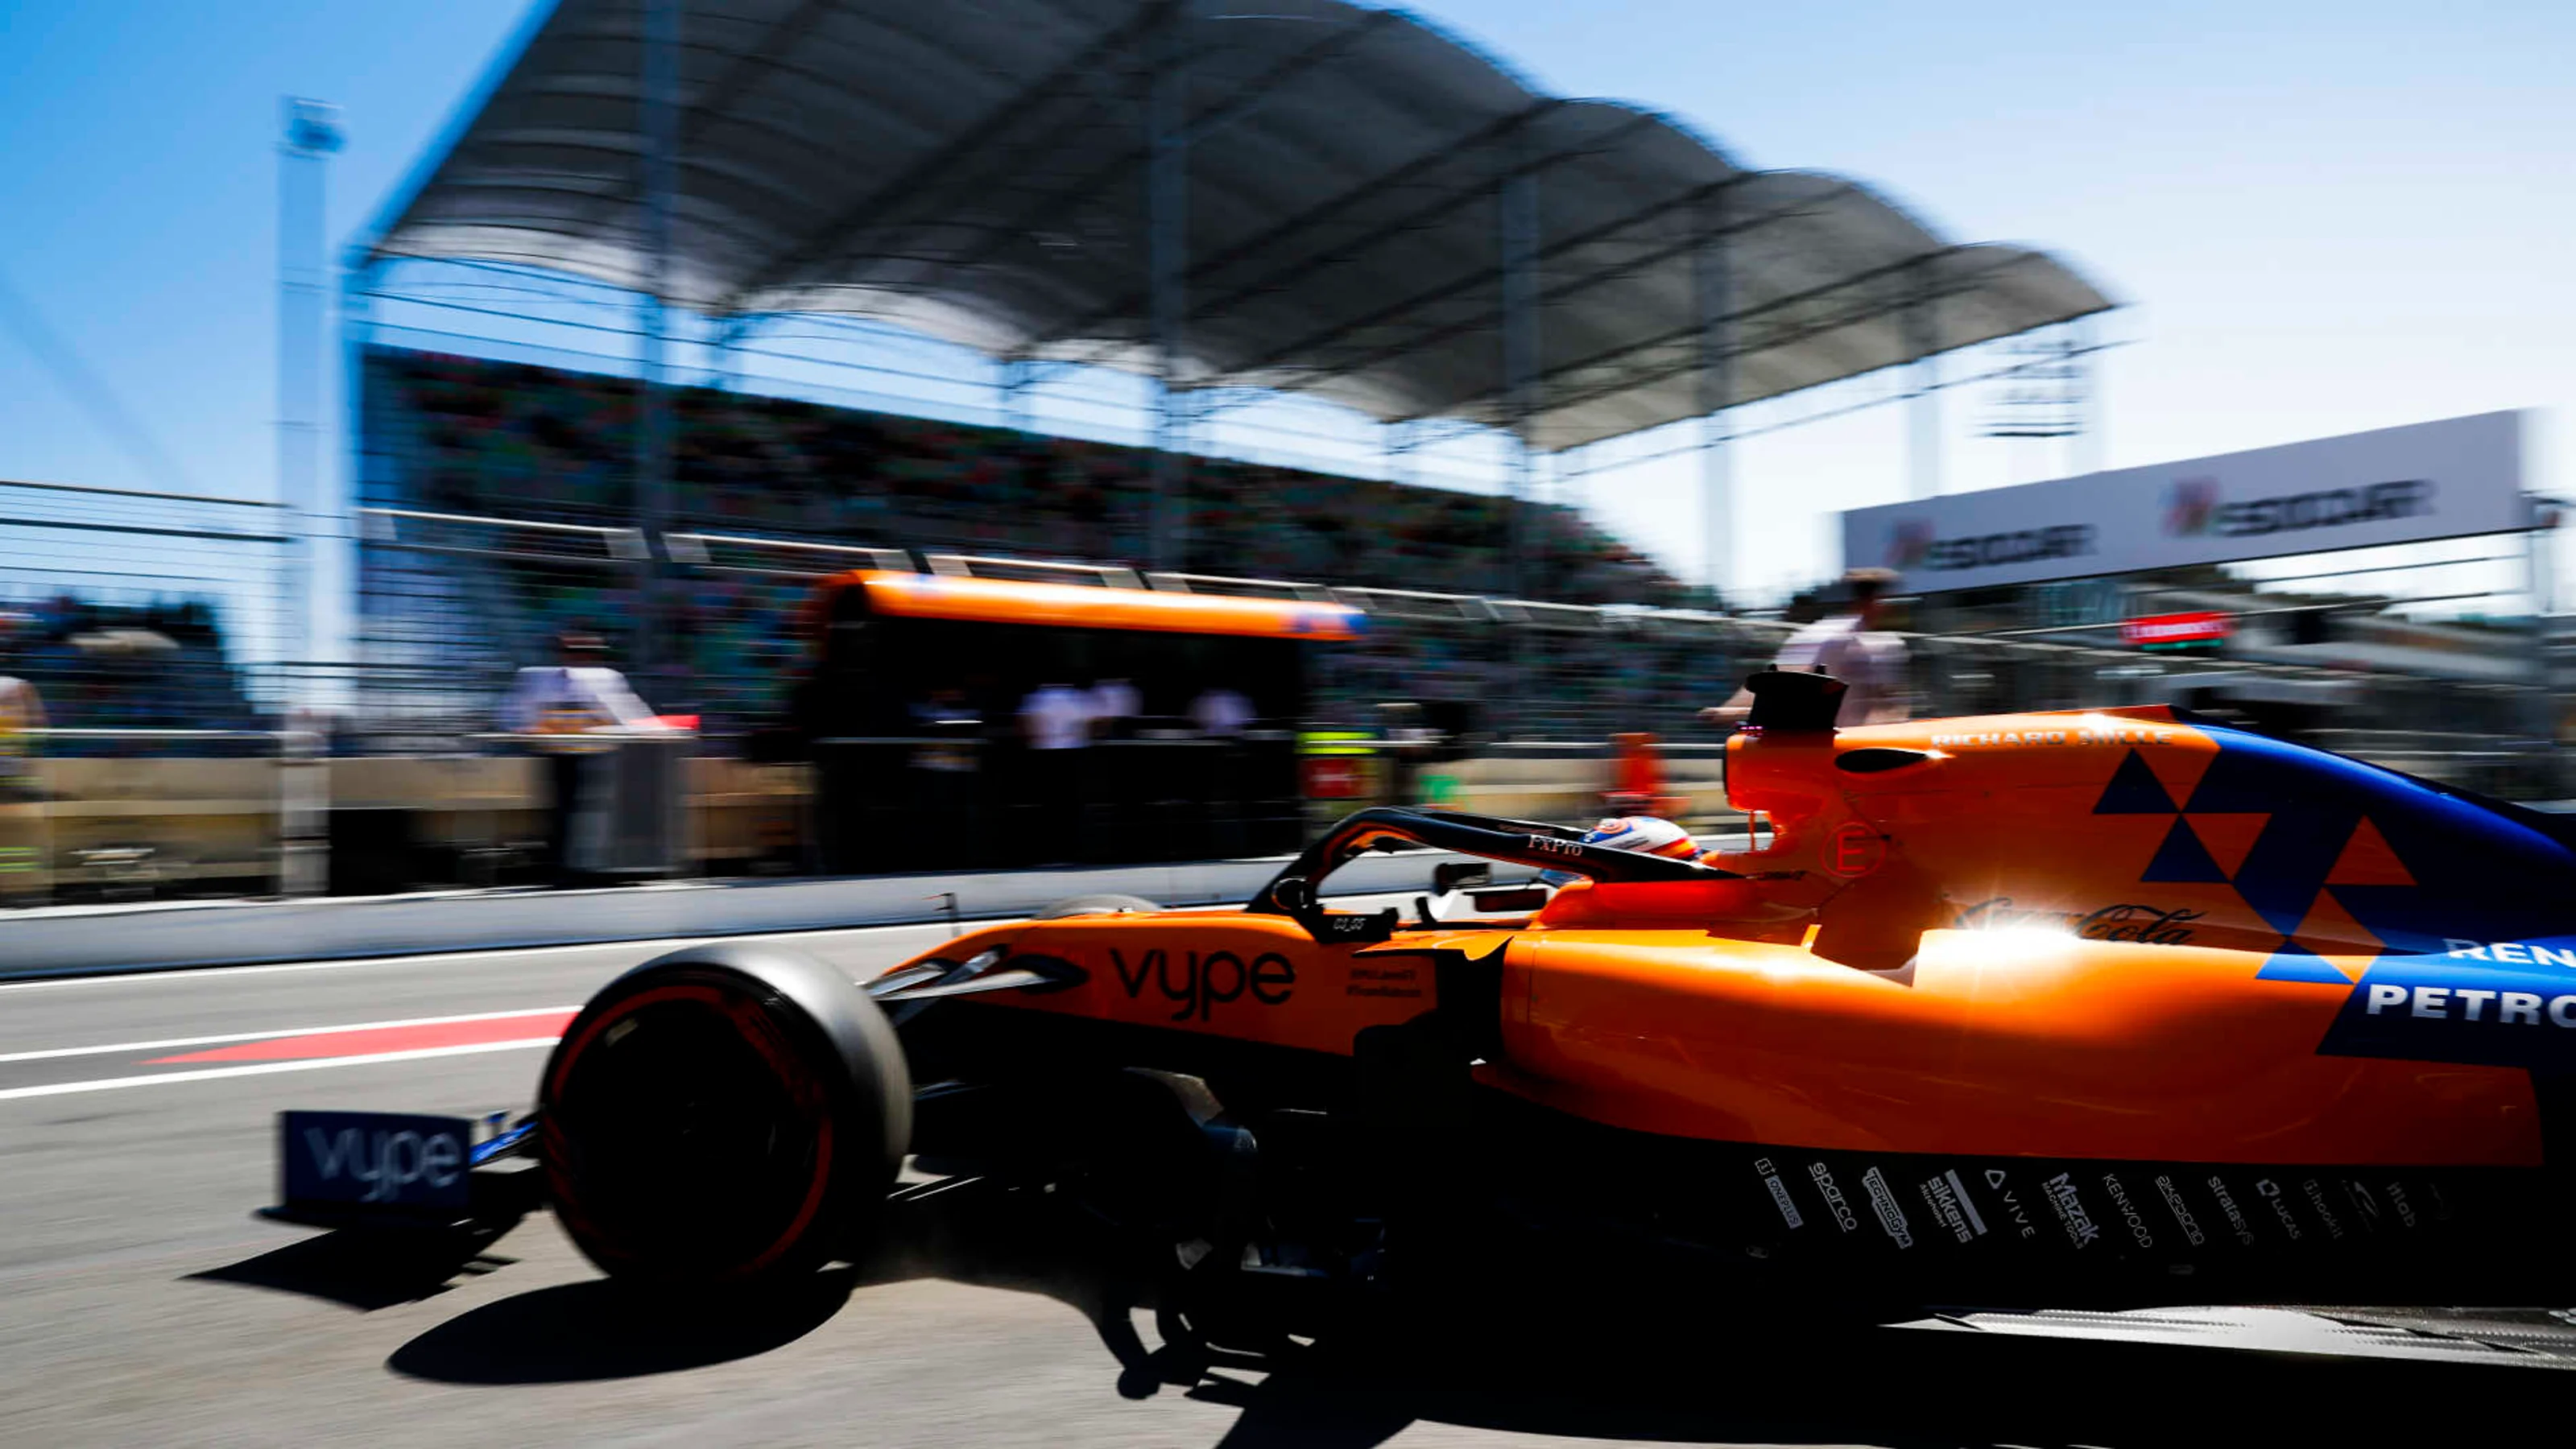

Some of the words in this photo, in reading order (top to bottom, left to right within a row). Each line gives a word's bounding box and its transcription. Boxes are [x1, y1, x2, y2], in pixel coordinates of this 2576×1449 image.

[1930, 730, 2065, 747] RICHARD
[2078, 729, 2172, 745] MILLE
[1837, 831, 1867, 871] E
[2442, 938, 2576, 968] REN
[1109, 947, 1296, 1022] vype
[304, 1127, 461, 1203] vype
[1767, 1176, 1802, 1228] ONEPLUS
[1809, 1162, 1858, 1232] sparco
[1928, 1177, 1972, 1242] sikkens
[2003, 1190, 2036, 1238] VIVE
[2042, 1183, 2067, 1220] MACHINE
[2049, 1173, 2098, 1244] Mazak
[2103, 1173, 2153, 1248] KENWOOD
[2207, 1176, 2254, 1245] stratasys
[2272, 1197, 2302, 1240] LUCAS
